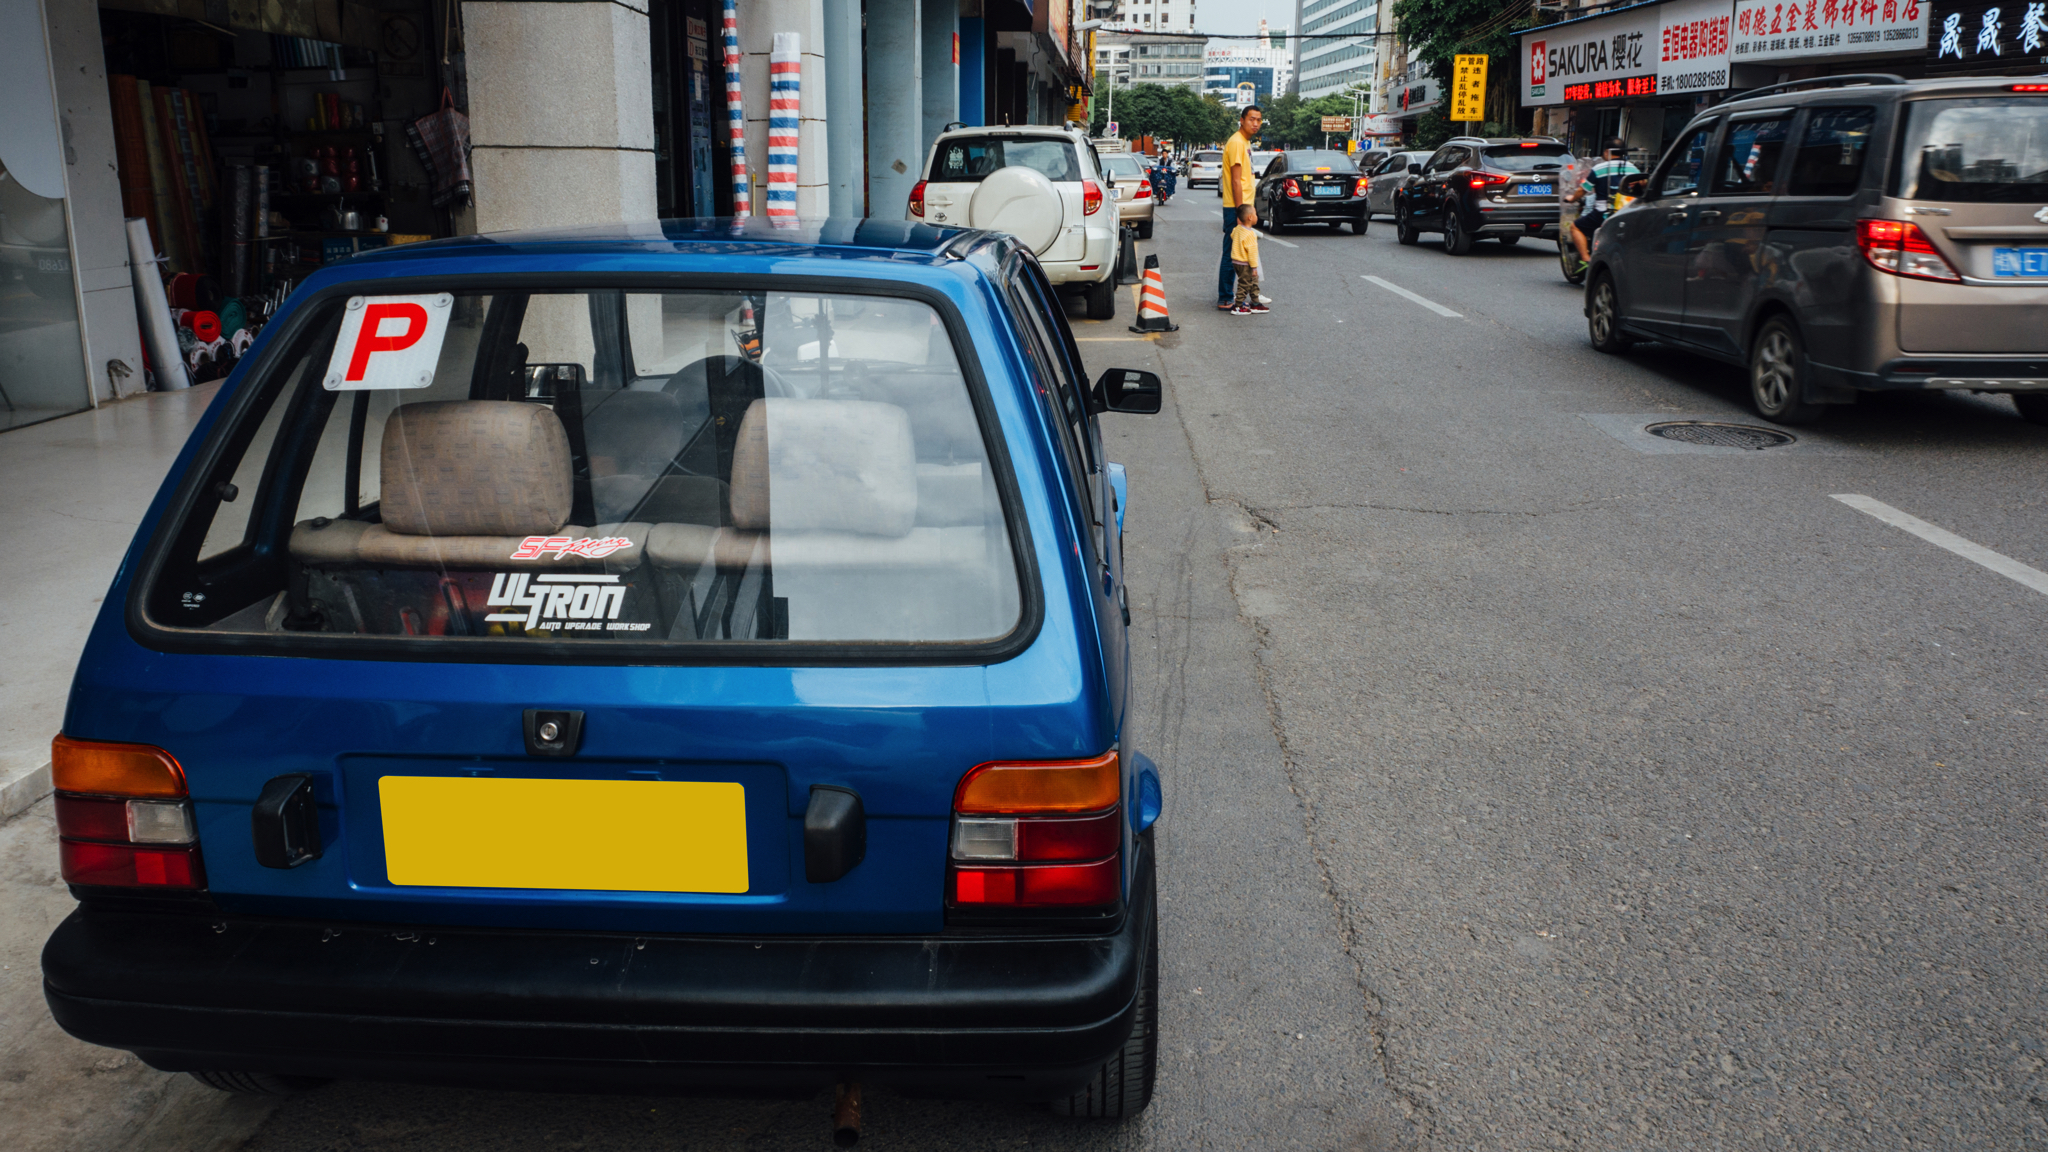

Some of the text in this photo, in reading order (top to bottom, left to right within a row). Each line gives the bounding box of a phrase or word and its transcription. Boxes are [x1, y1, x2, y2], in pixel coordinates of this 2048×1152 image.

[1548, 31, 1643, 78] SAKURA 樱花
[345, 303, 428, 381] P
[512, 536, 632, 561] SF Racing
[485, 573, 627, 631] ULTRON
[538, 621, 652, 632] AUTO UPGRADE WORKSHOP
